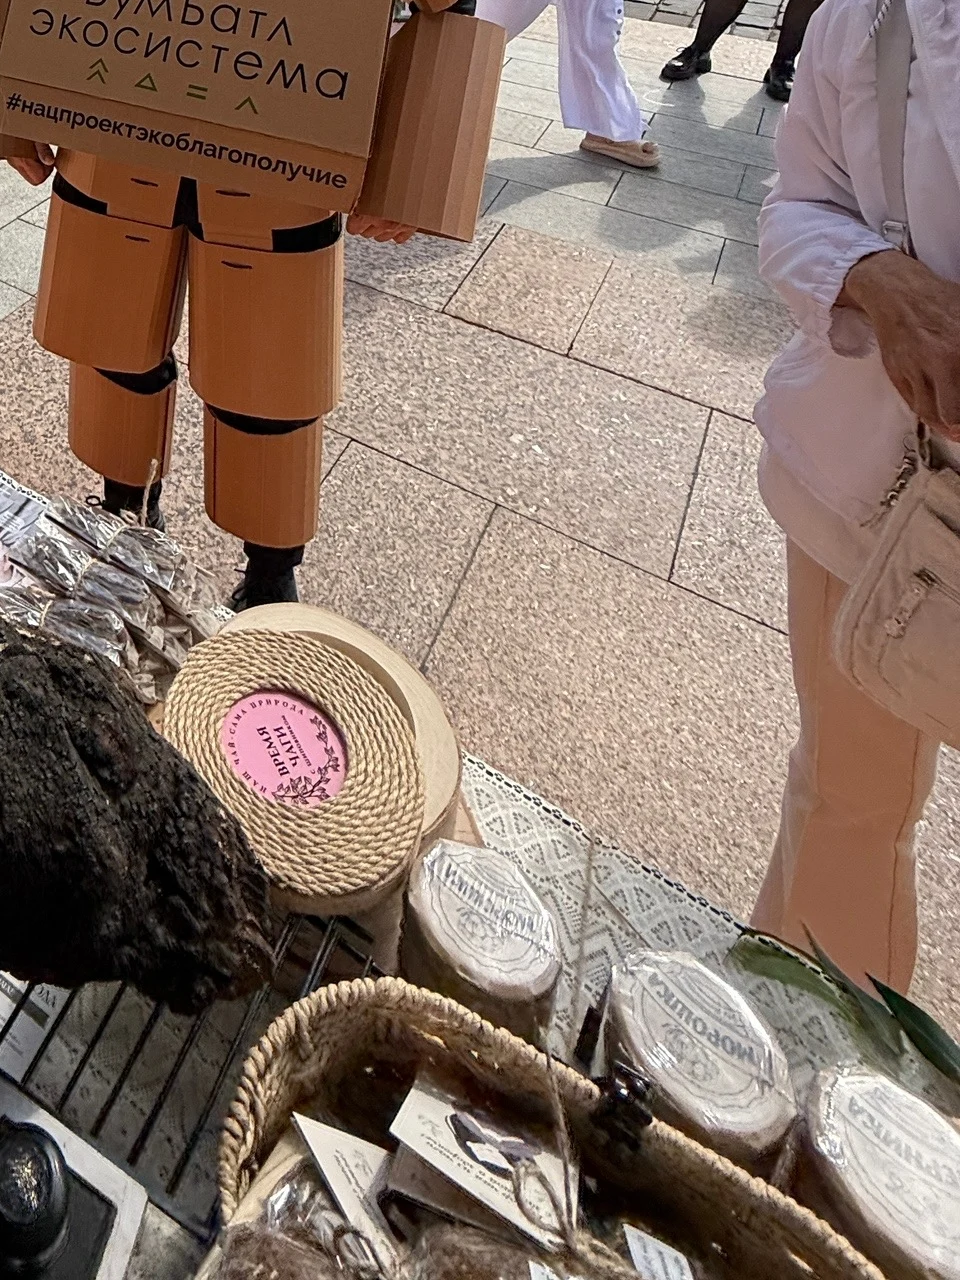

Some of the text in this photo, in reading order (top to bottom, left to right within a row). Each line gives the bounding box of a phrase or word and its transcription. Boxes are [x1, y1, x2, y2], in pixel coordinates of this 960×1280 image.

[28, 8, 350, 102] экосистема
[6, 91, 348, 190] #нацпроектэкоблагополучие
[249, 698, 305, 716] ПРИРОДА
[256, 726, 291, 777] ВРЕМЯ
[273, 725, 298, 767] ЧАГИ
[281, 714, 313, 767] ШИПОВНИКОМ
[241, 769, 268, 795] НАШ
[646, 970, 761, 1073] МОРОШКА
[848, 1095, 960, 1190] ЕРНИКА
